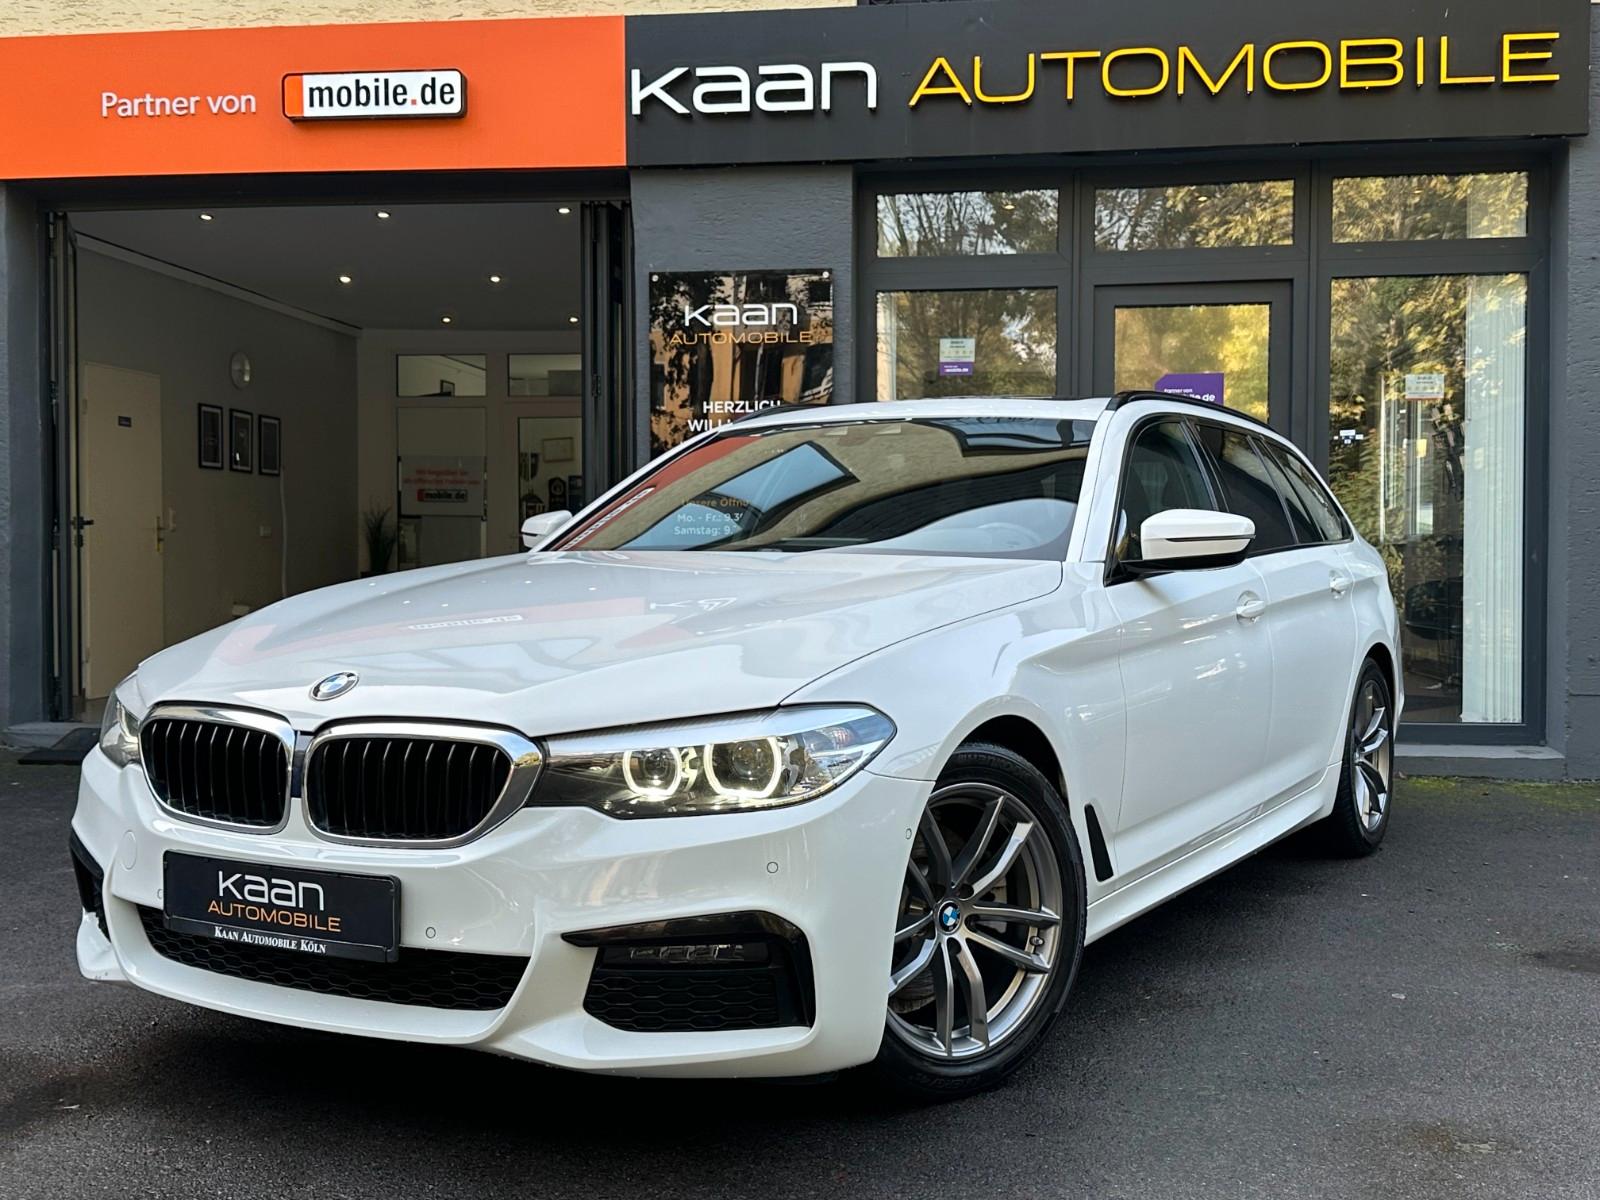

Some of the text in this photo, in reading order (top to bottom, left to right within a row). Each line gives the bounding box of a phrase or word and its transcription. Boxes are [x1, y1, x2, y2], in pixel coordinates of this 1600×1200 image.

[909, 32, 1560, 107] AUTOMOBILE
[101, 92, 257, 117] Partner von
[308, 78, 456, 108] mobile.de
[670, 331, 814, 345] AUTOMOBILE
[674, 526, 720, 536] Samstag:
[208, 900, 342, 933] AUTOMOBILE
